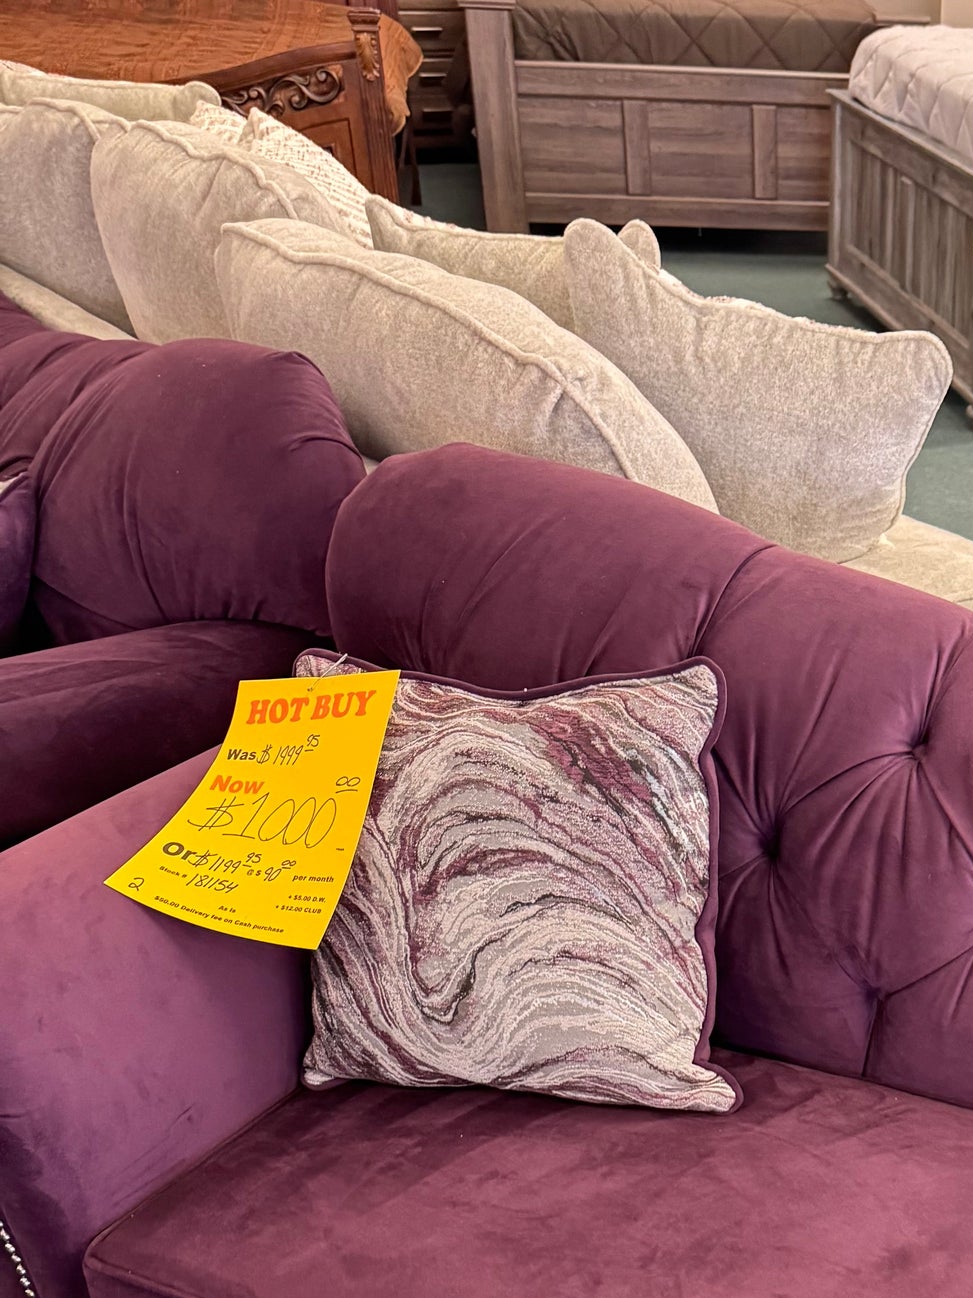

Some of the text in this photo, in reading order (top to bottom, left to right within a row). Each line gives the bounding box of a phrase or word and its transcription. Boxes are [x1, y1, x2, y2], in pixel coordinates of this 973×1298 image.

[246, 689, 377, 725] HOT BUY
[227, 749, 256, 761] Was
[209, 774, 265, 794] Now
[159, 866, 180, 877] Stock
[162, 841, 197, 861] Or
[292, 874, 307, 882] per
[308, 875, 335, 883] month
[180, 905, 212, 919] Delivery
[234, 919, 252, 928] Cash
[252, 924, 284, 933] purchase
